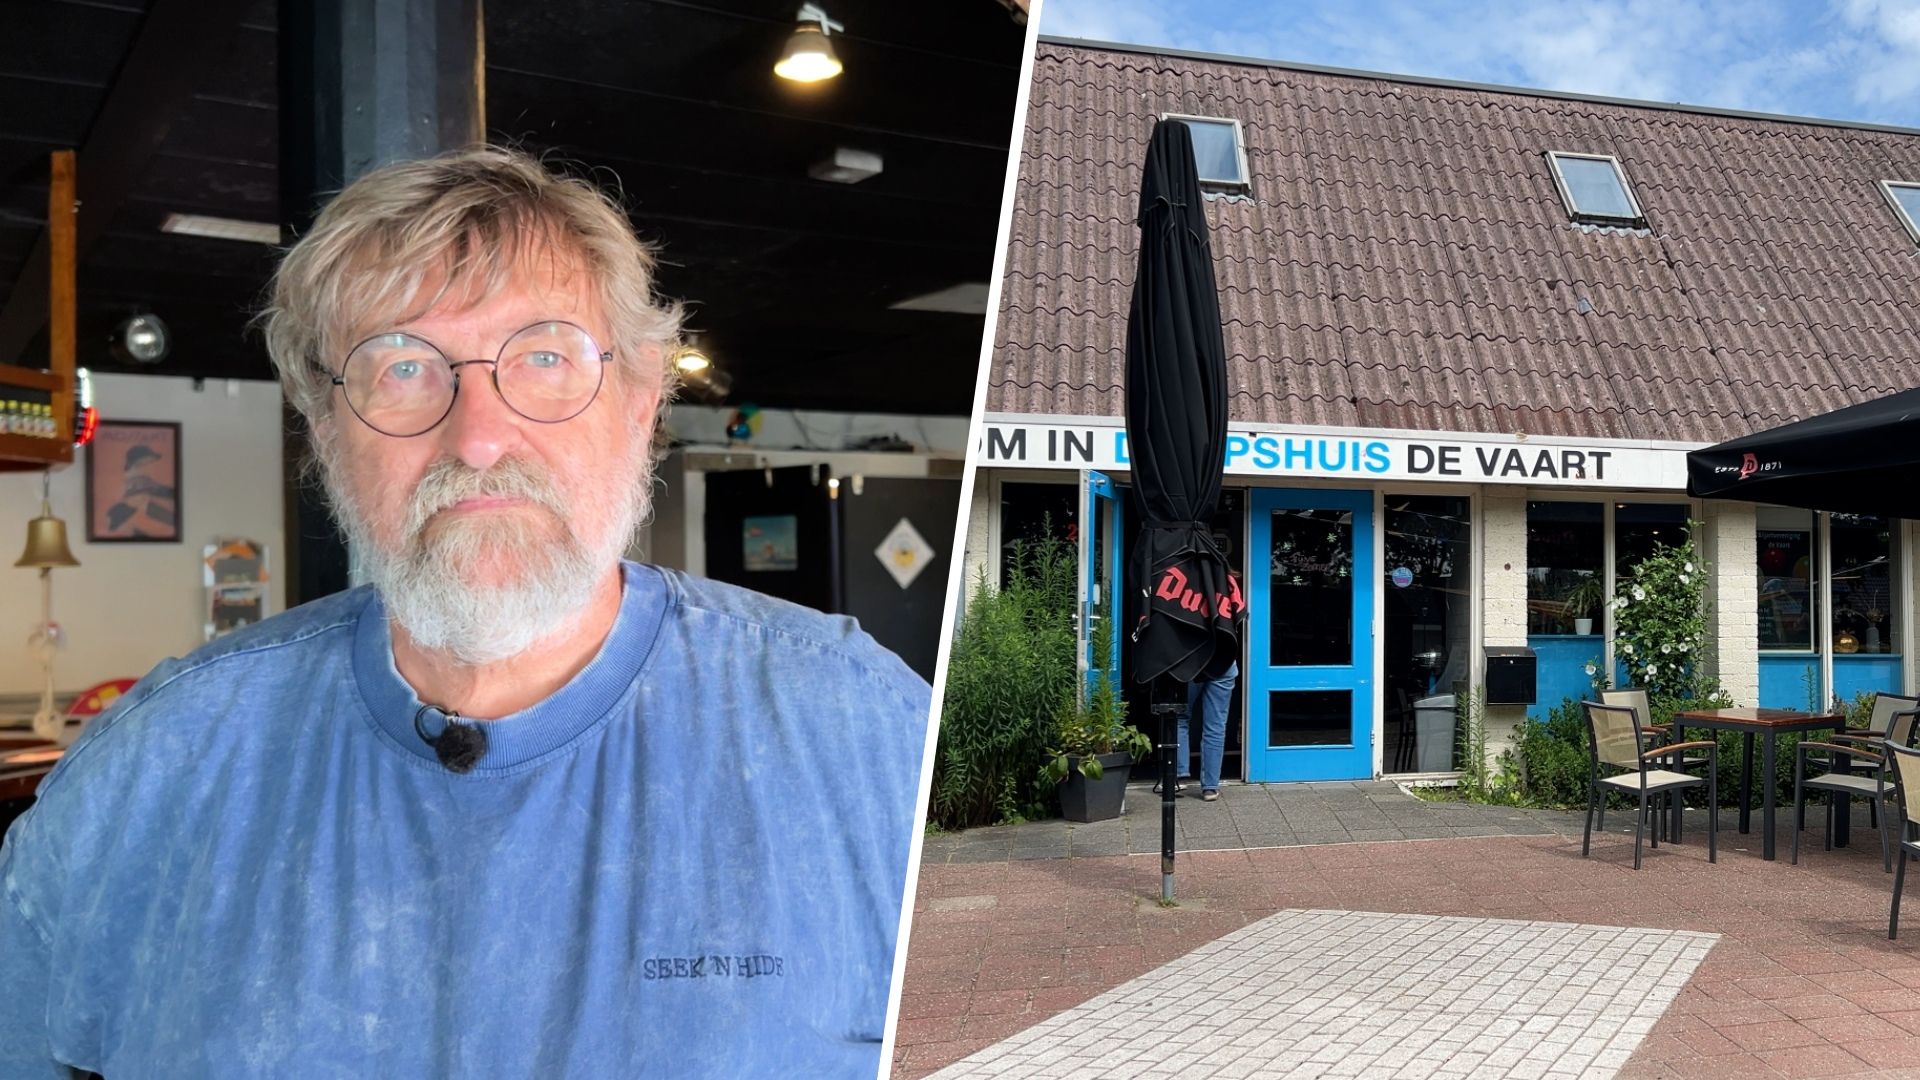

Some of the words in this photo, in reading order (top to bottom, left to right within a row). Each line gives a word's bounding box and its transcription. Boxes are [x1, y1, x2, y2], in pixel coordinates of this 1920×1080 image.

[979, 427, 1026, 461] M
[1048, 429, 1094, 462] IN
[1115, 431, 1391, 474] DPSHUIS
[1407, 444, 1462, 475] DE
[1475, 447, 1612, 480] VAART
[1760, 461, 1782, 471] 1871
[643, 956, 707, 980] SEEK
